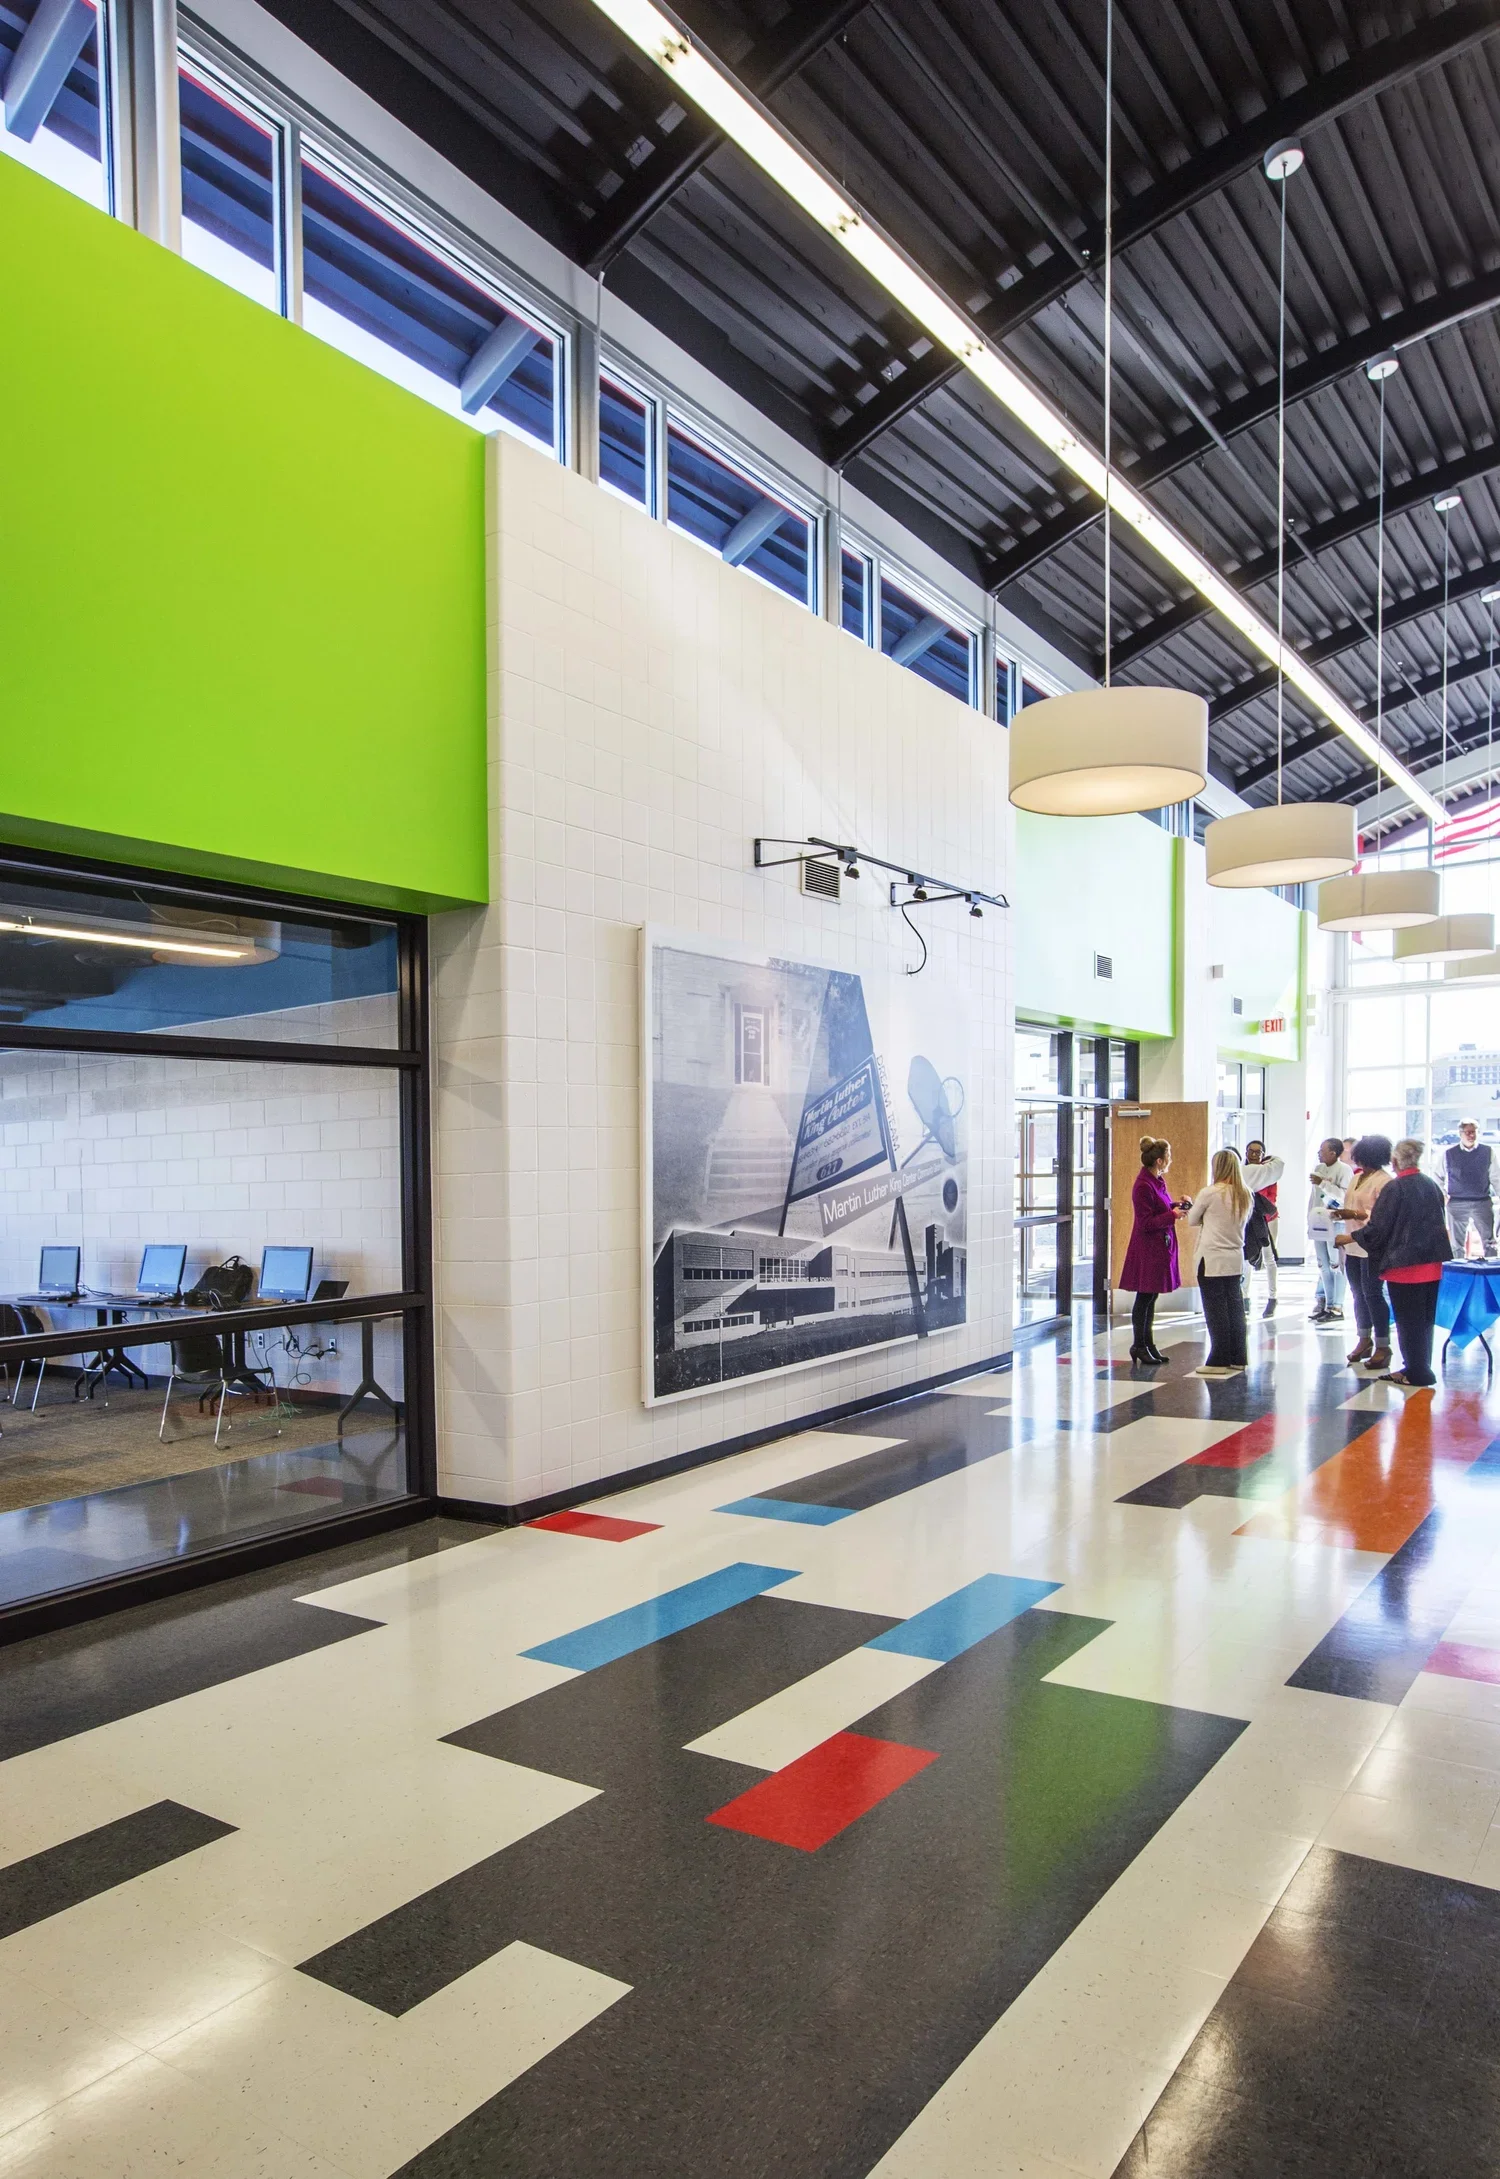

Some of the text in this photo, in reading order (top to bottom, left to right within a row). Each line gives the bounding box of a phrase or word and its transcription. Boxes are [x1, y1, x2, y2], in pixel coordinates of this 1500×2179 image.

[1265, 1018, 1283, 1033] EXIT
[804, 1112, 827, 1140] King
[827, 1091, 866, 1130] Center
[805, 1098, 833, 1125] Martin
[834, 1073, 868, 1107] Luther
[876, 1055, 900, 1152] DREAM TEAM
[822, 1193, 862, 1225] Martin
[863, 1183, 889, 1205] Luther
[889, 1176, 902, 1194] King
[902, 1171, 916, 1187] Center
